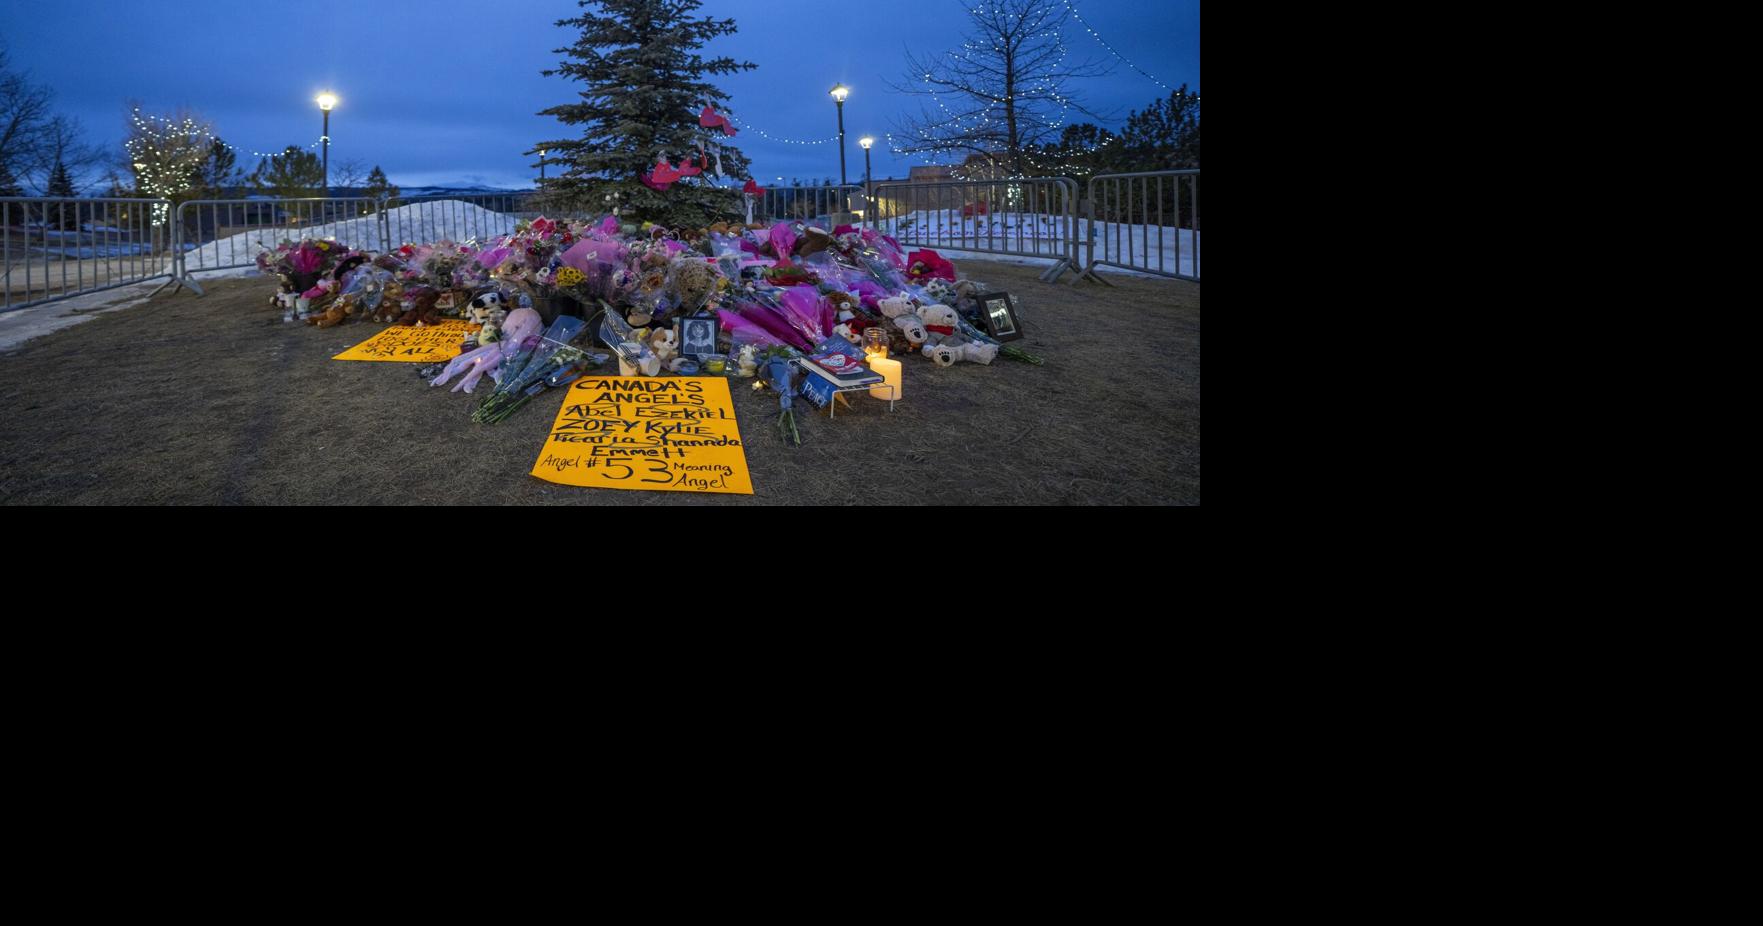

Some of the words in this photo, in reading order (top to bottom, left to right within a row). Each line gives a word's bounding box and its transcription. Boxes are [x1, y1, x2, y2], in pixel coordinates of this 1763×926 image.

[575, 379, 704, 393] CANADA'S
[593, 392, 705, 406] ANGEL'S
[564, 404, 622, 417] Abel
[556, 418, 641, 433] ZOEY
[541, 454, 580, 472] Angel
[673, 462, 733, 477] Meaning
[671, 474, 728, 491] Angel
